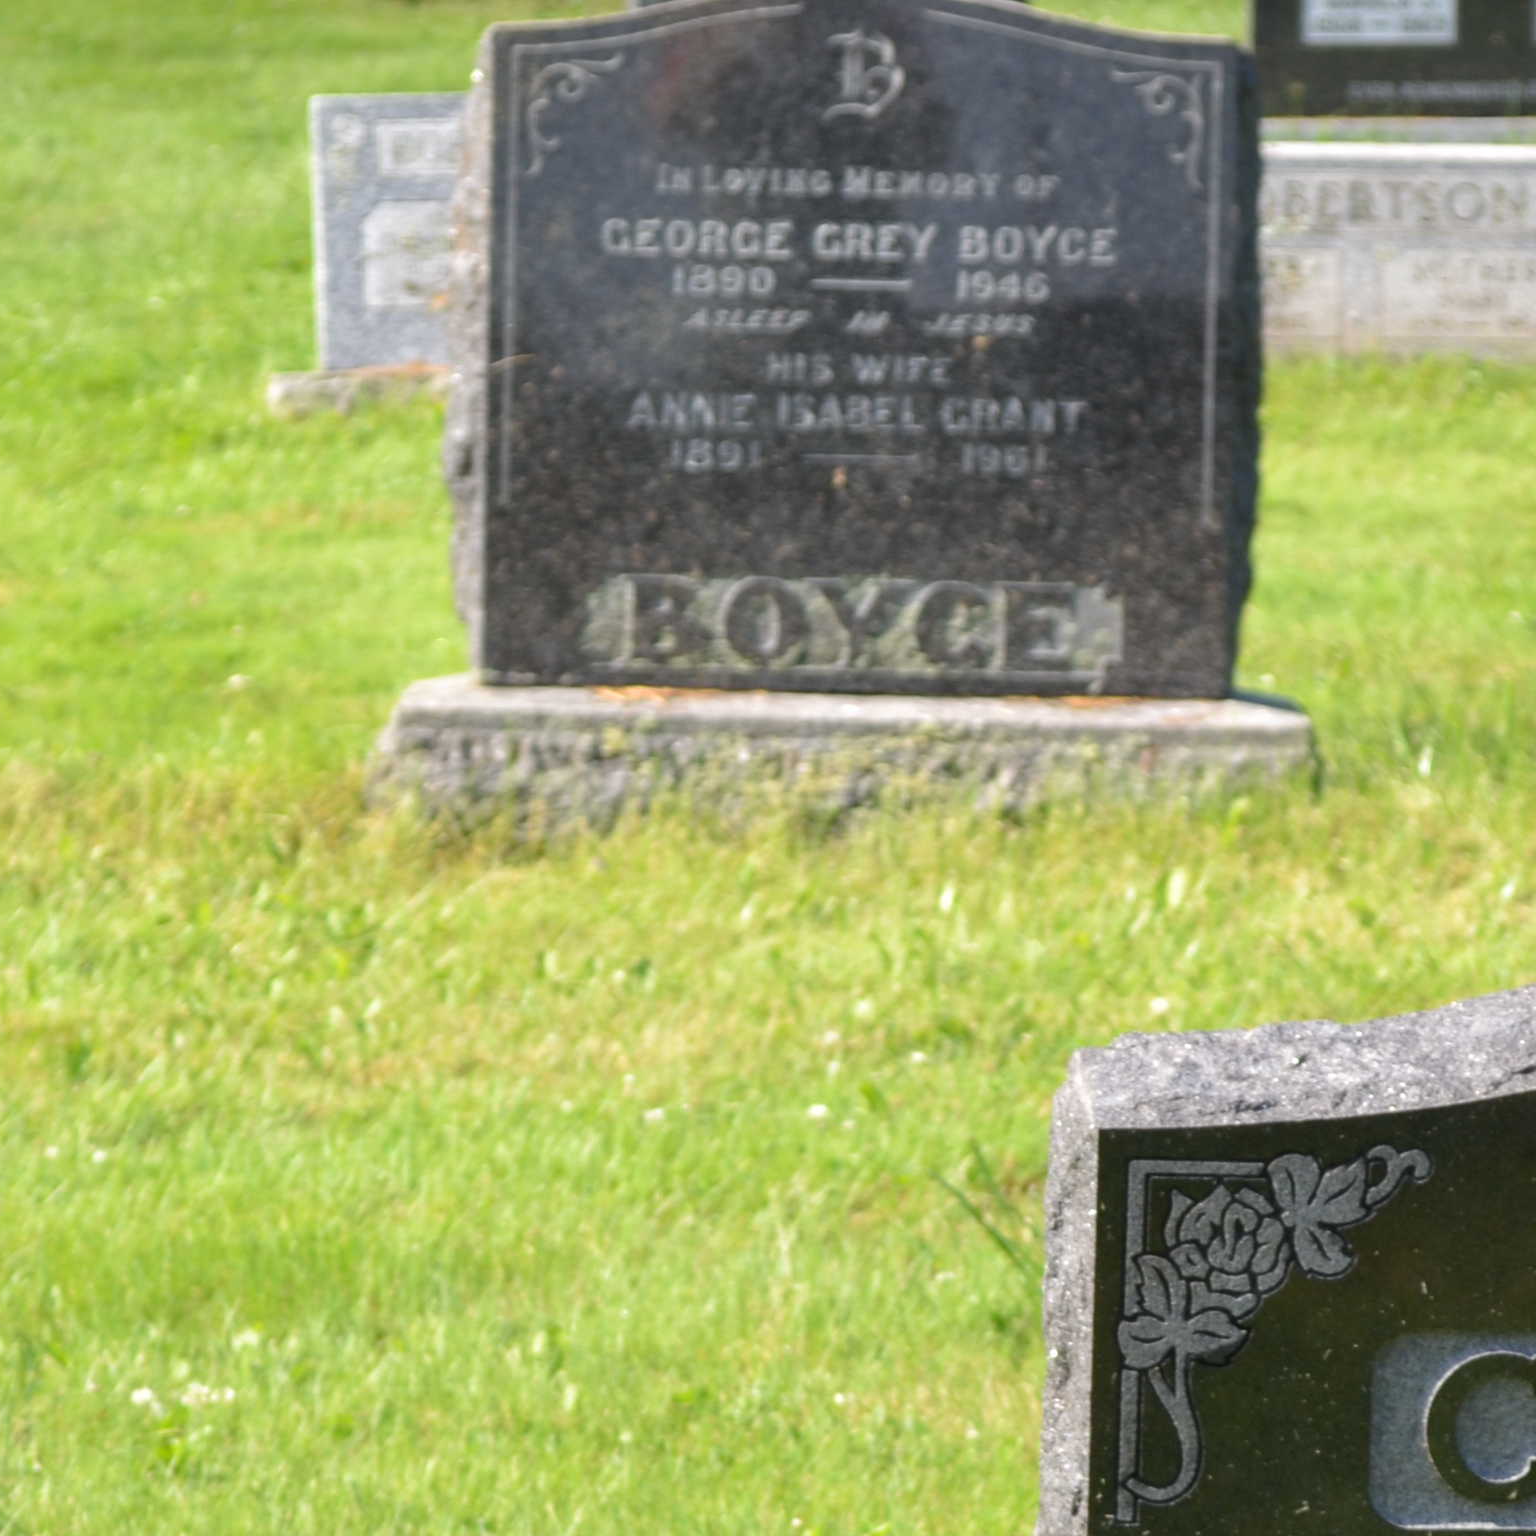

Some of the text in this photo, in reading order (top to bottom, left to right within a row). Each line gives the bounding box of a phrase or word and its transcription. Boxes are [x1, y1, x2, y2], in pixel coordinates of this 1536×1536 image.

[1260, 177, 1530, 225] BERTSON
[601, 216, 1120, 268] GEORGE GREY BOYCE
[671, 264, 778, 298] 1890
[953, 269, 1051, 303] 1946
[682, 306, 1038, 337] ASLEEP IN JESUS
[767, 351, 954, 385] HIS WIFE
[625, 391, 1089, 435] ANNIE ISABEL GRANT
[614, 572, 1080, 672] BOYCE
